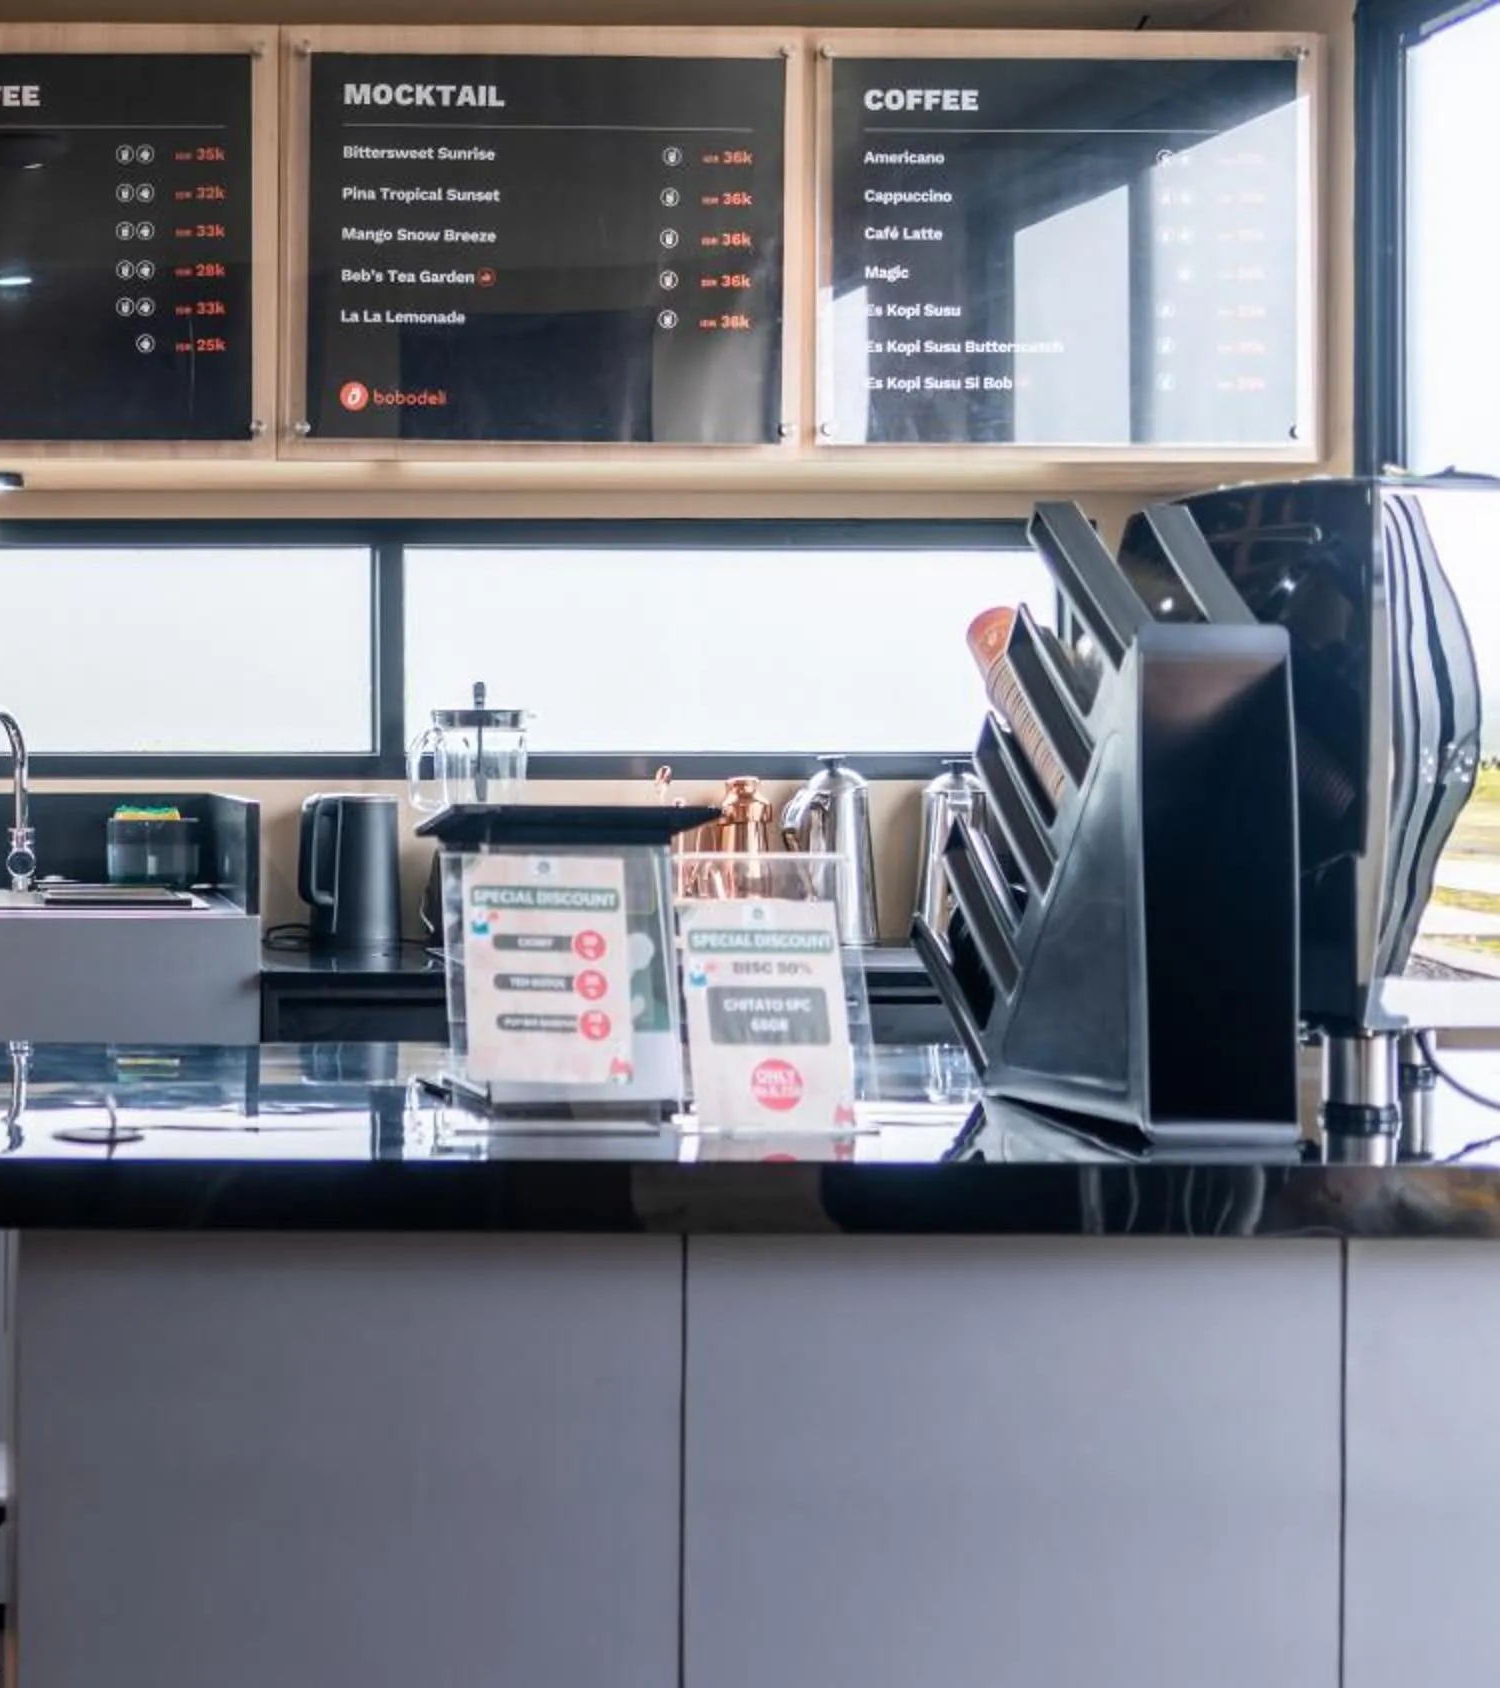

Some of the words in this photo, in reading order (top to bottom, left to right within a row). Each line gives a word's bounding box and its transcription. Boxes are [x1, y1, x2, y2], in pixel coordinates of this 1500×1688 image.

[343, 83, 505, 107] MOCKTAIL
[864, 90, 979, 111] COFFEE
[343, 145, 434, 159] Bittersweet
[437, 147, 496, 160] Sunrise
[864, 151, 945, 164] Americano
[380, 187, 443, 204] Tropical
[446, 189, 500, 202] Sunset
[864, 189, 952, 204] Cappuccino
[341, 227, 393, 243] Mango
[397, 228, 440, 241] Snow
[444, 229, 497, 243] Breeze
[864, 226, 899, 240] Café
[903, 228, 943, 240] Latte
[388, 270, 416, 283] Tea
[419, 270, 475, 284] Garden
[864, 265, 909, 282] Magic
[340, 310, 359, 322] La
[363, 310, 382, 322] La
[386, 310, 466, 324] Lemonade
[865, 304, 883, 317] Es
[887, 303, 920, 319] Kopi
[923, 304, 962, 317] Susu
[887, 340, 920, 356] Kopi
[924, 341, 961, 353] Susu
[887, 376, 920, 392] Kopi
[924, 377, 961, 389] Susu
[964, 376, 979, 389] Si
[984, 376, 1013, 389] Bob
[373, 390, 447, 405] bobodeli
[474, 889, 534, 905] SPECIAL
[537, 891, 617, 907] DISCOUNT
[692, 935, 751, 947] SPECIAL
[756, 935, 832, 948] DISCOUNT
[732, 961, 772, 975] DISC
[723, 999, 783, 1012] CHITATO
